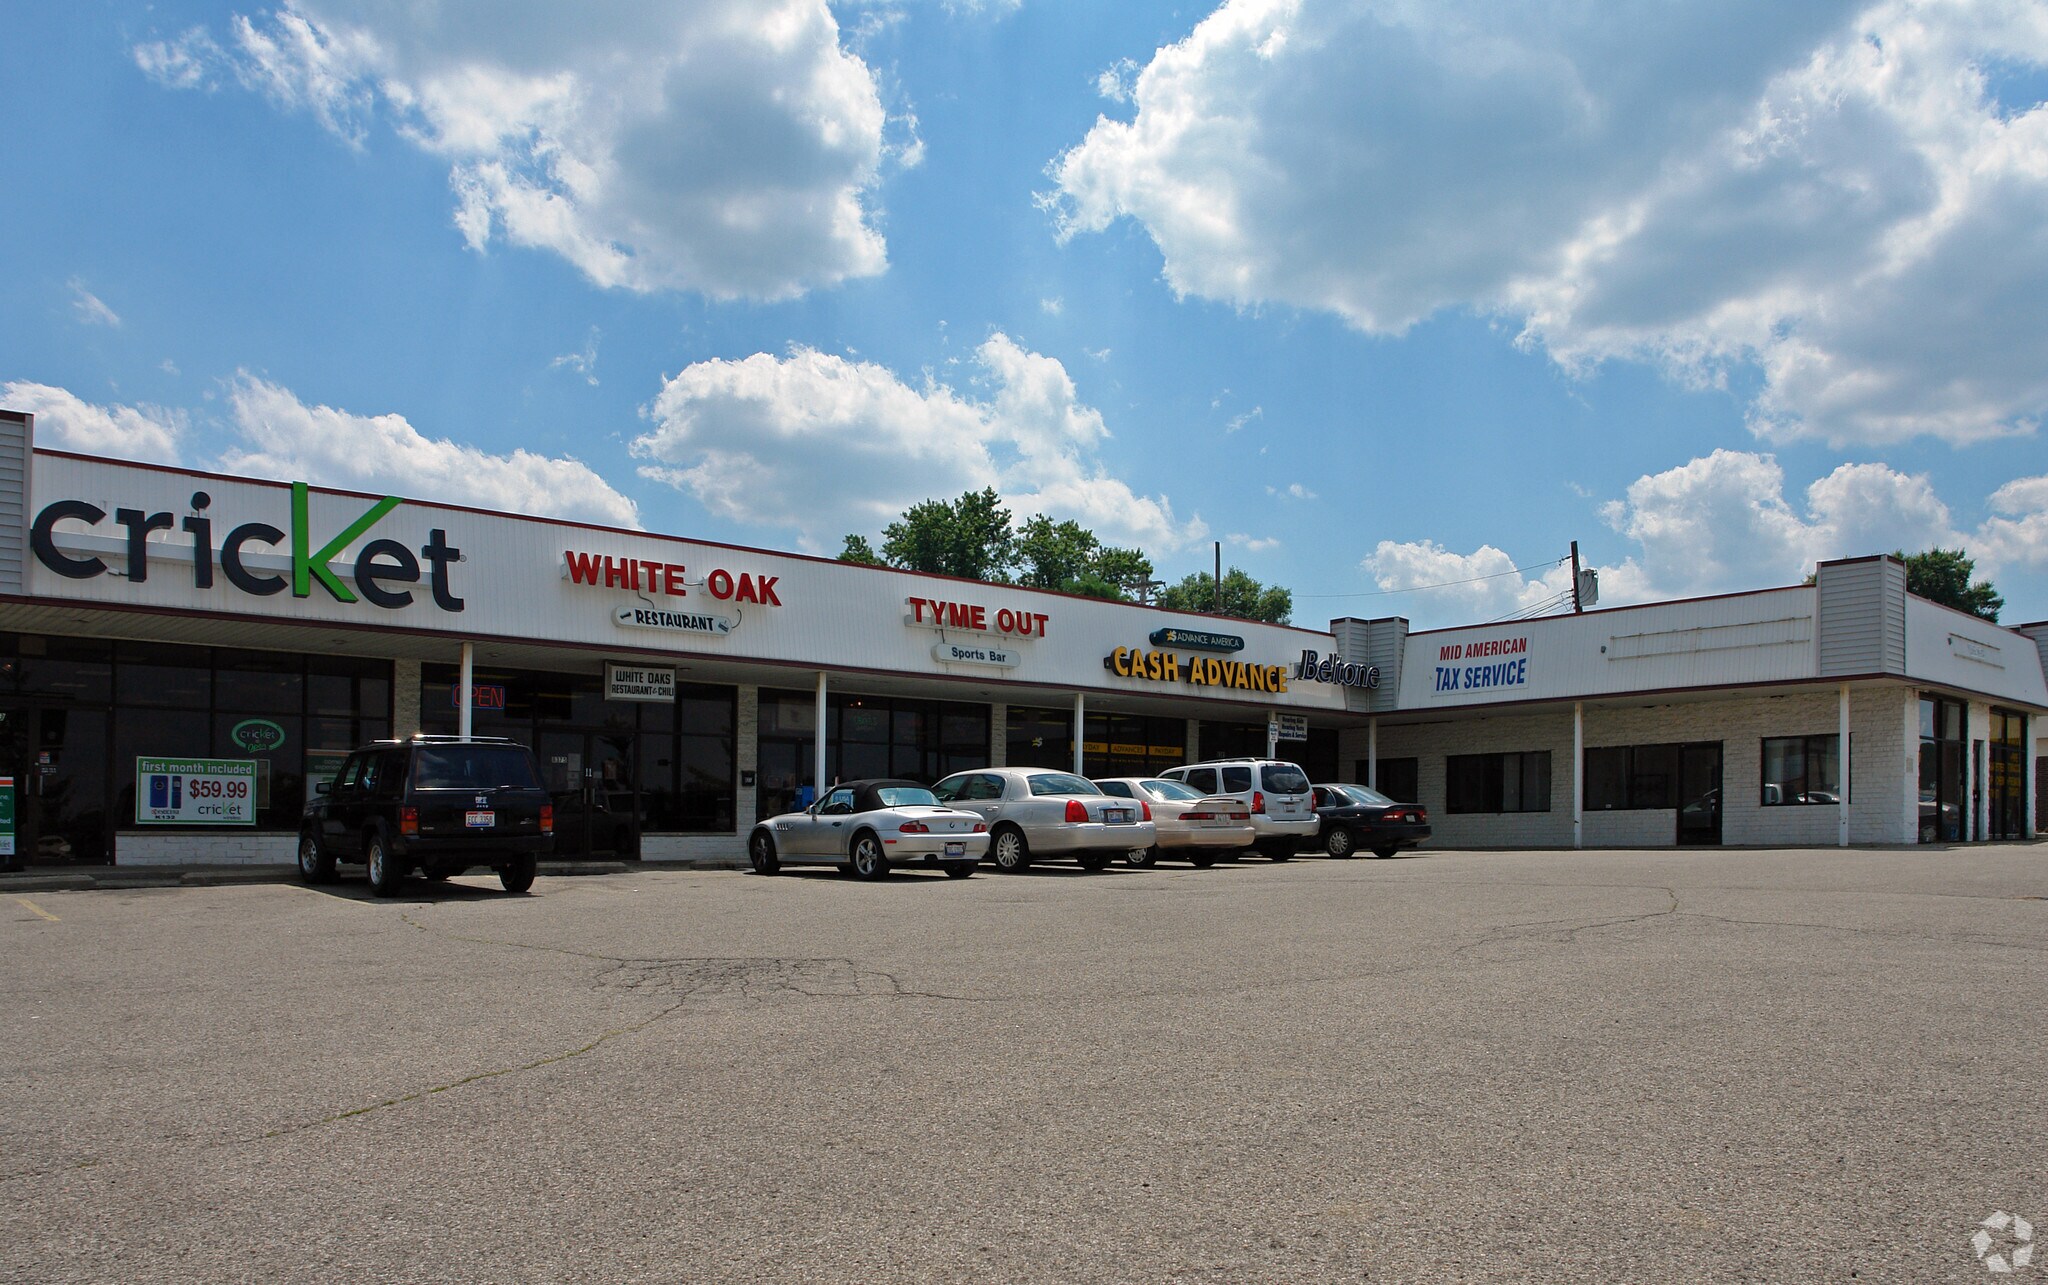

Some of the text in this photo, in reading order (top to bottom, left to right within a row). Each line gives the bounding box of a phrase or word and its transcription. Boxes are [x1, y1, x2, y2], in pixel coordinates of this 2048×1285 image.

[31, 481, 465, 612] cricket
[565, 550, 782, 606] WHITE OAK
[635, 609, 713, 631] RESTAURANT
[909, 597, 1049, 637] TYME OUT
[1177, 634, 1239, 647] ADVANCE AMERICA
[1440, 638, 1527, 661] MID AMERICAN
[951, 647, 1006, 662] Sports Bar
[616, 670, 670, 684] WHITE OAKS
[1114, 646, 1288, 693] CASH ADVANCE
[1301, 650, 1380, 689] Beltone
[1436, 658, 1526, 691] TAX SERVICE
[612, 684, 652, 695] RESTAURANT
[142, 761, 252, 774] first month included
[190, 779, 247, 799] $59.99
[198, 801, 242, 815] cricket
